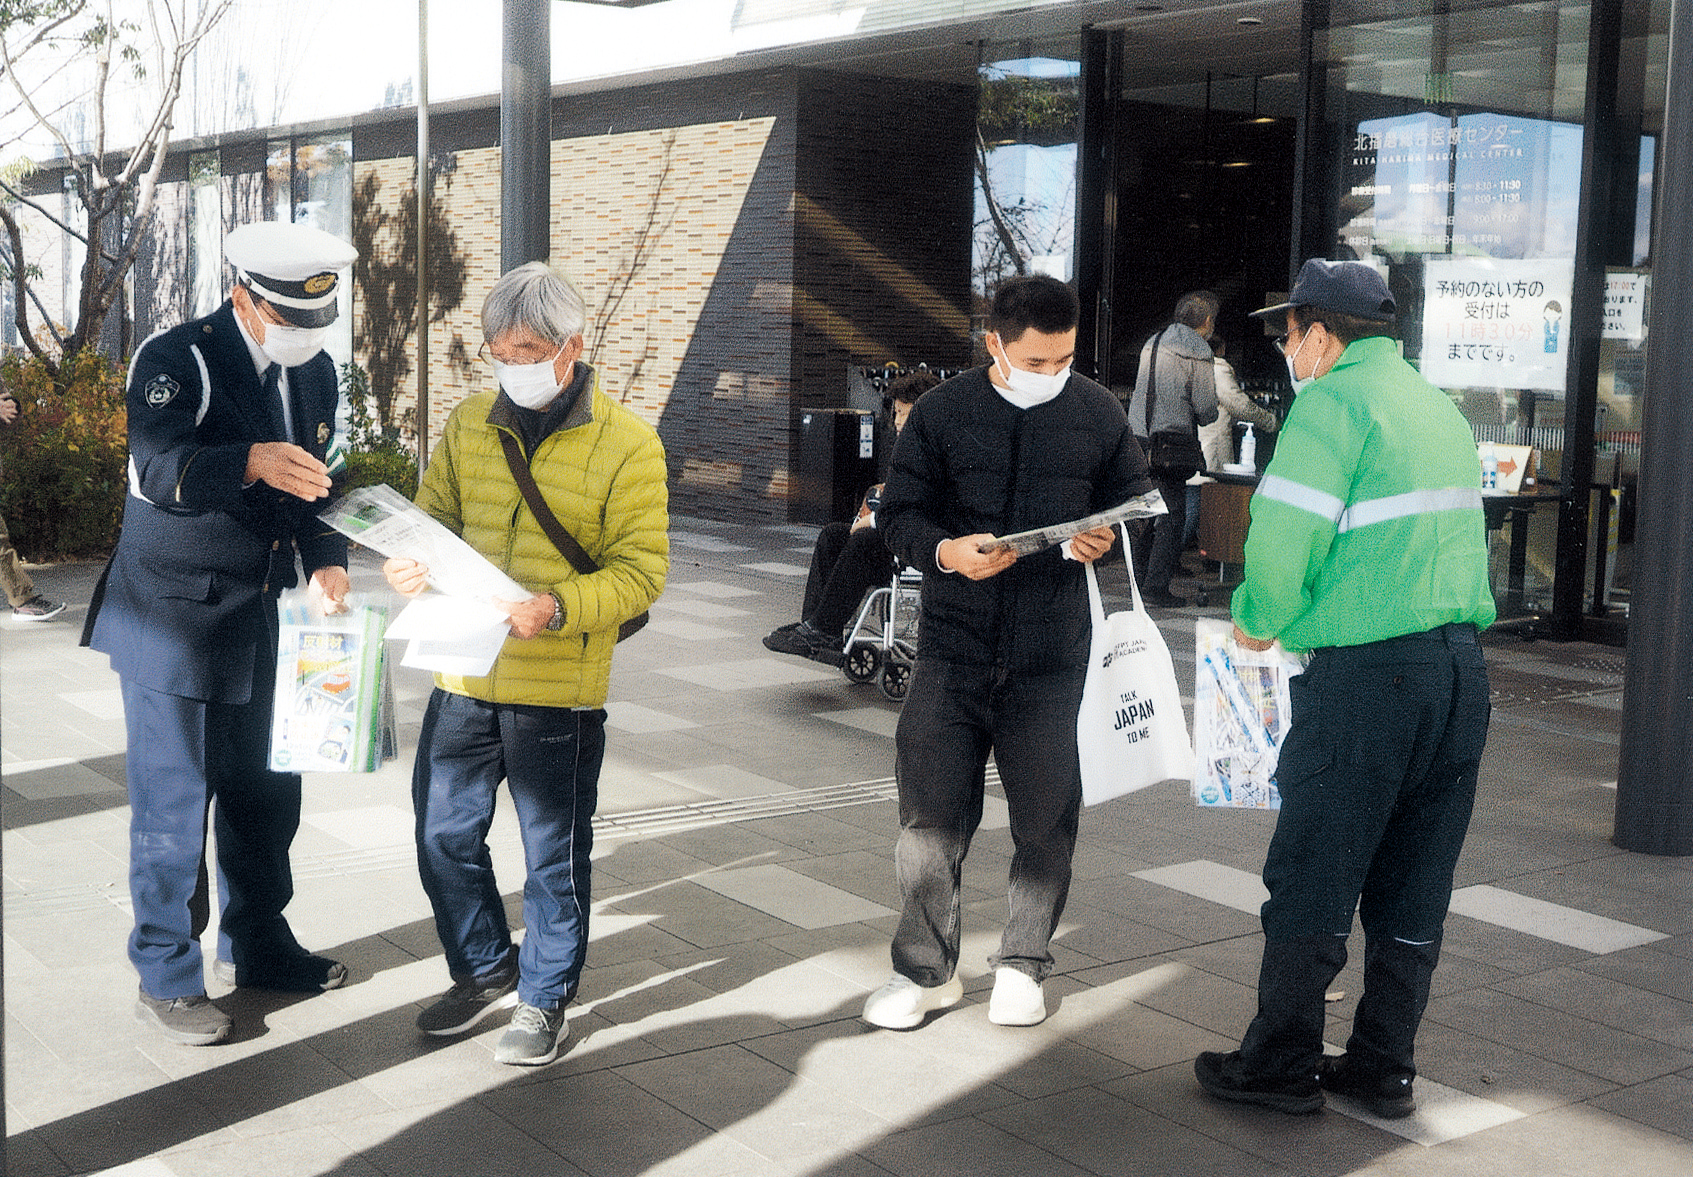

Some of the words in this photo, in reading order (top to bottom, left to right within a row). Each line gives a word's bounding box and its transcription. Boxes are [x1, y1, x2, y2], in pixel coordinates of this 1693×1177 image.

[1353, 157, 1377, 166] KITA
[1426, 150, 1475, 162] MEDICAL
[1435, 279, 1545, 299] 予約のない方の
[1464, 301, 1511, 320] 受付は
[1445, 322, 1534, 341] 11時30分
[1447, 343, 1516, 363] までです。
[1121, 690, 1138, 704] TALK
[1114, 698, 1156, 731] JAPAN
[1127, 730, 1139, 744] TO
[1139, 726, 1150, 741] ME
